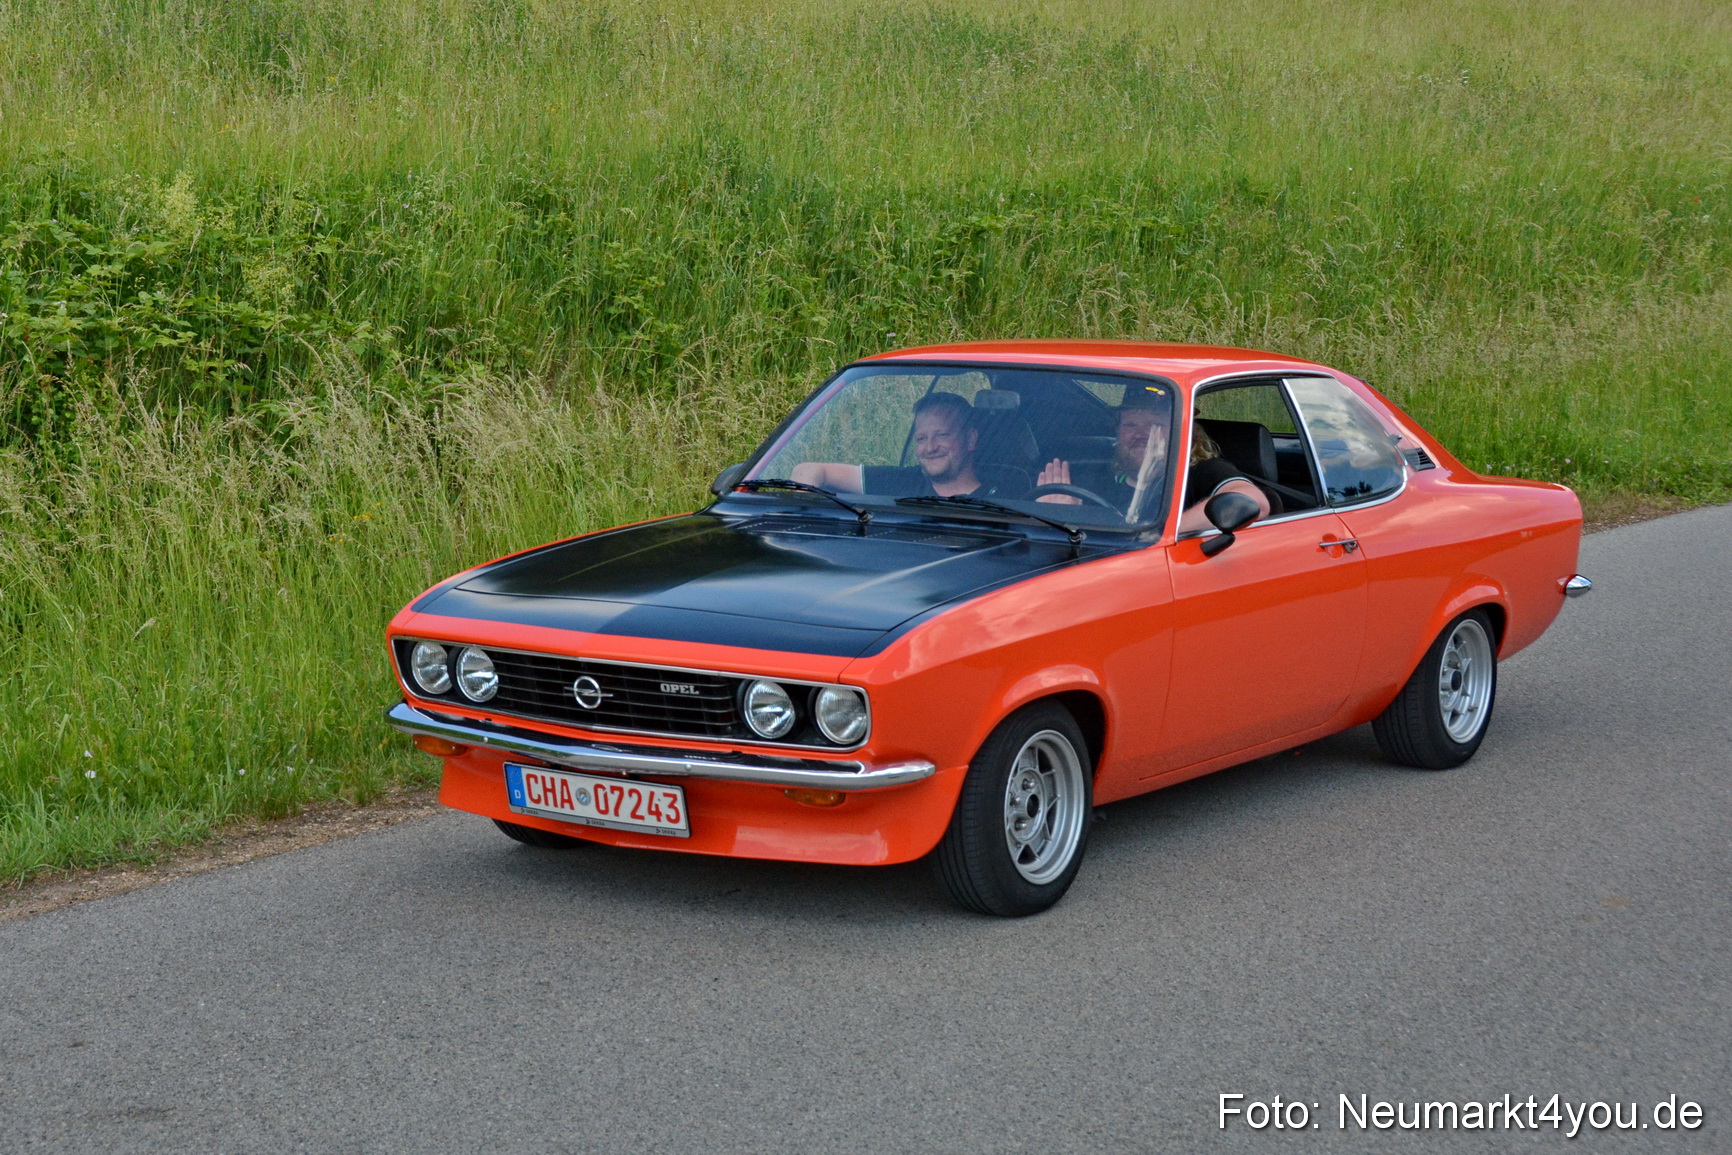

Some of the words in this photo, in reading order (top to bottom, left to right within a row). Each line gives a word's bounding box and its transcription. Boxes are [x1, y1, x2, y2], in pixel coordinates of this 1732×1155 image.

[660, 683, 699, 695] OPEL
[514, 789, 522, 799] D
[525, 773, 575, 811] CHA
[593, 783, 681, 824] 07243
